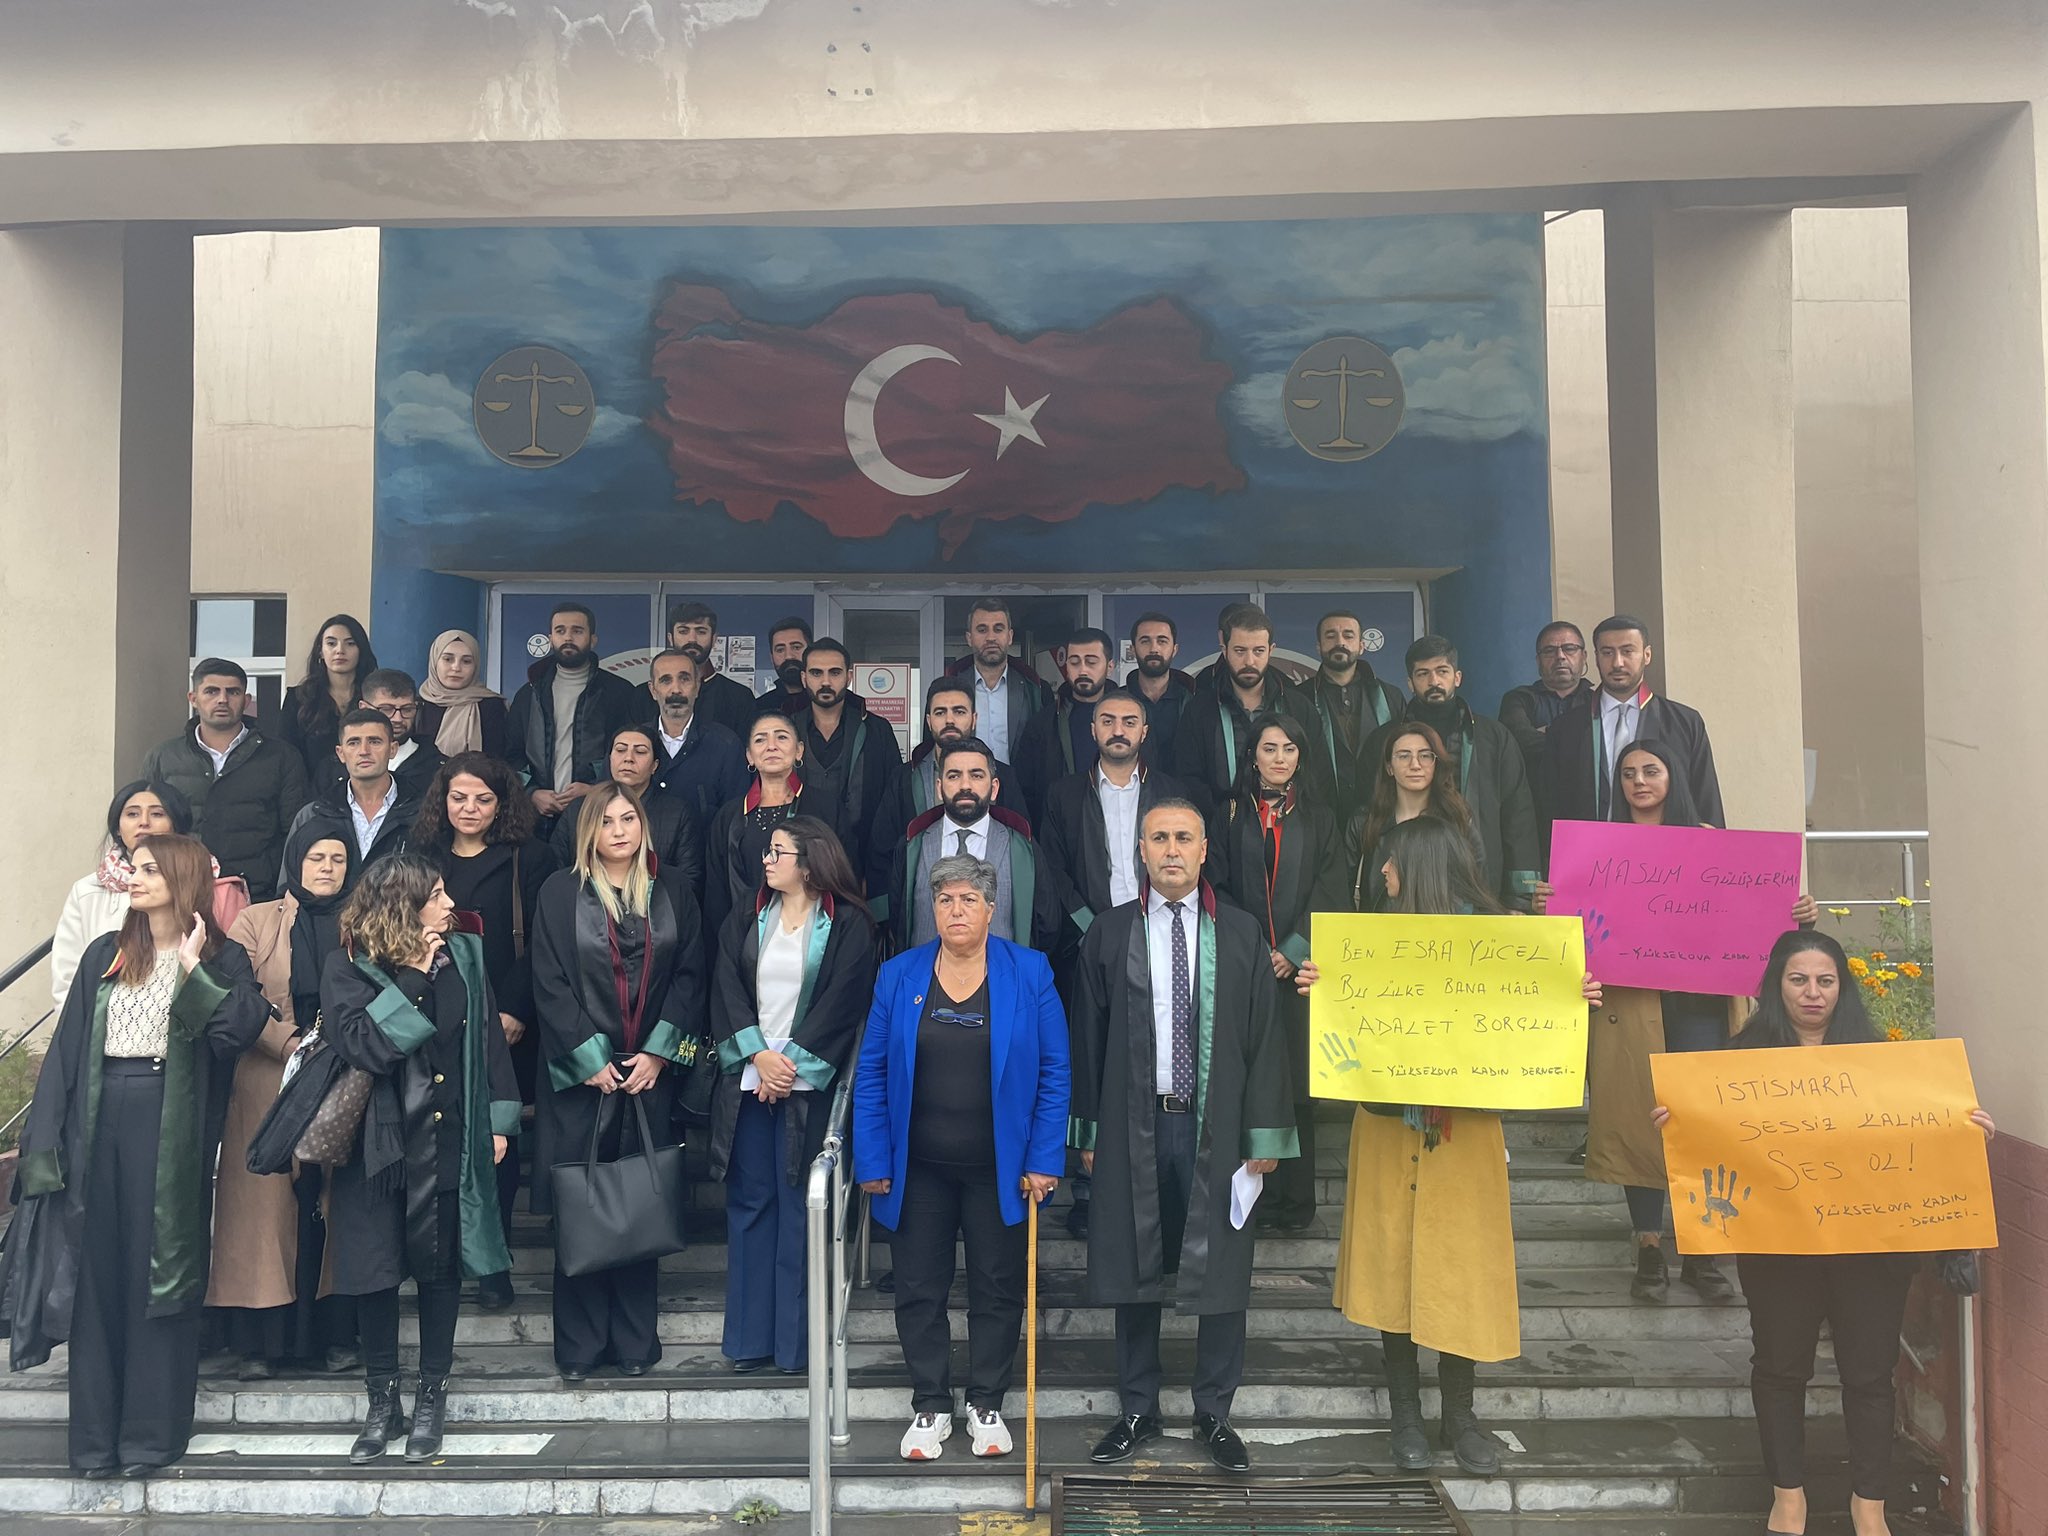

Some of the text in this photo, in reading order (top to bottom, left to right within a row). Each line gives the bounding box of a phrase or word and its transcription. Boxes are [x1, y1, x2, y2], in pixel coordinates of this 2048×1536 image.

[1588, 857, 1683, 888] MASUM
[1340, 937, 1375, 963] BEN
[1390, 939, 1454, 962] ESRA
[1469, 938, 1549, 967] YÜCEL
[1333, 973, 1369, 1002] BU
[1376, 979, 1426, 998] ÜLKE
[1444, 977, 1487, 995] BANA
[1471, 1066, 1510, 1076] KADIN
[1714, 1072, 1858, 1105] İSTİSMARA
[1739, 1116, 1837, 1142] SESSİZ
[1767, 1149, 1843, 1191] SES
[1813, 1193, 1967, 1226] YÜKSEKOVA KADIN
